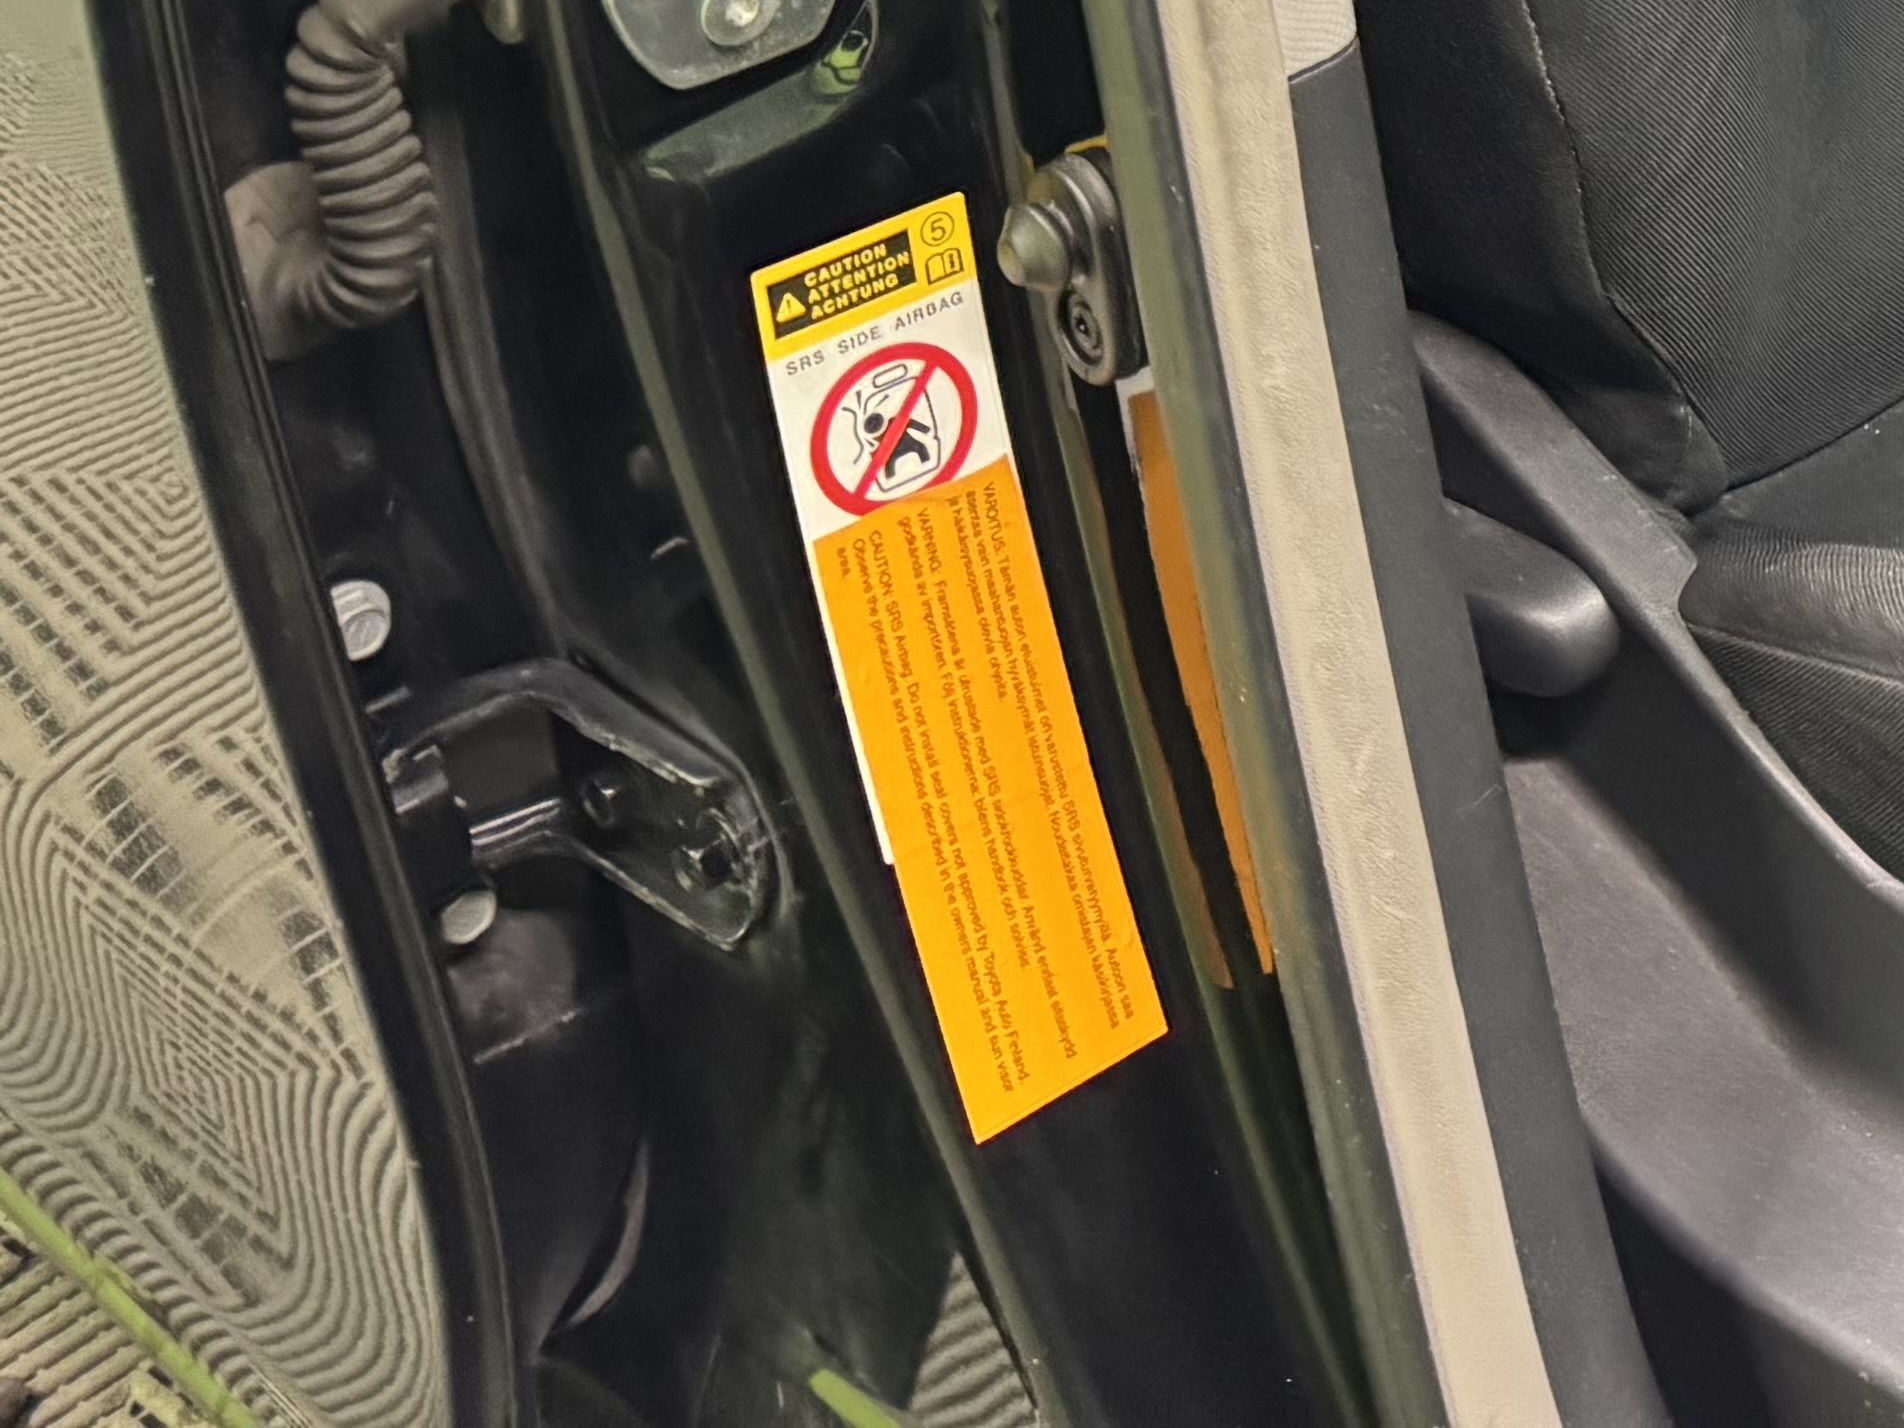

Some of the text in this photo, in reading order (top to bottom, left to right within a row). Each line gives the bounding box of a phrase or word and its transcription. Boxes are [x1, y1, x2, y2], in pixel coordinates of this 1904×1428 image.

[929, 218, 948, 243] 5
[805, 243, 887, 288] CAUTION
[809, 250, 910, 303] ATTENTION
[811, 273, 899, 320] ACHTUNG
[786, 291, 964, 377] SRS SIDE AIRBAG
[867, 595, 879, 617] the
[892, 698, 909, 723] and
[943, 882, 957, 905] the
[980, 1007, 998, 1033] and
[885, 600, 904, 633] SRS
[906, 681, 920, 704] Do
[913, 705, 927, 728] not
[952, 848, 967, 870] not
[983, 951, 1002, 997] Toyota
